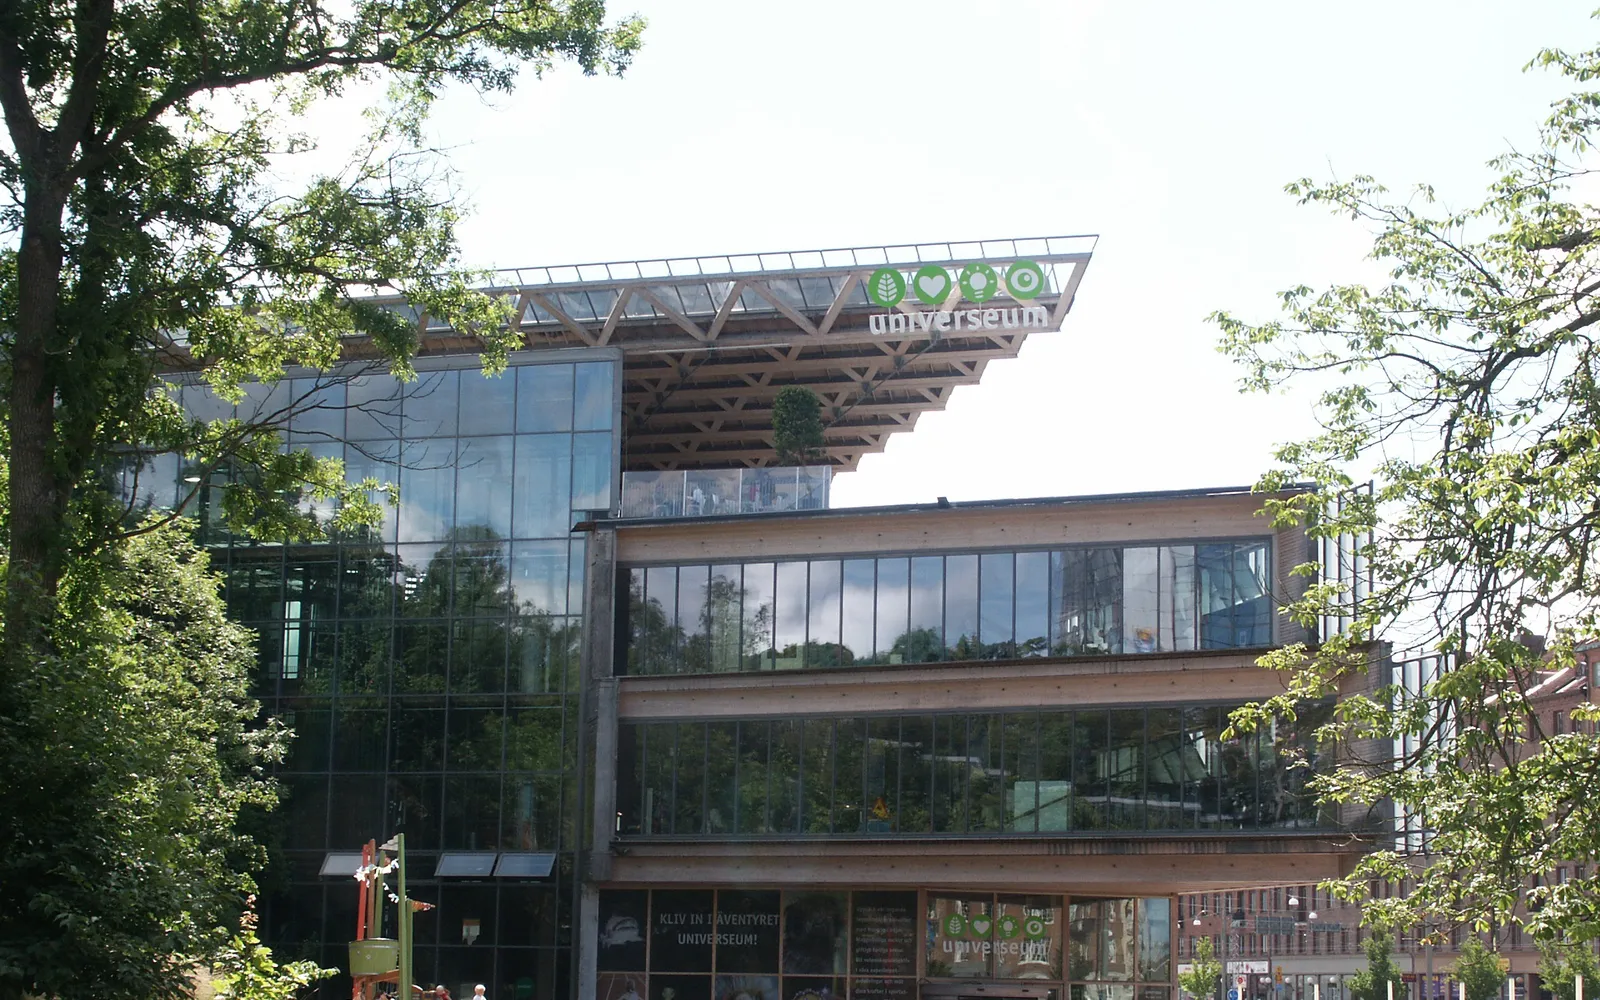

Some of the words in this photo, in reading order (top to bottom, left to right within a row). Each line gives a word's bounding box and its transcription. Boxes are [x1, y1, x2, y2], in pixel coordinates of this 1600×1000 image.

[868, 305, 1048, 336] universeum
[659, 913, 687, 925] KLIV
[690, 913, 703, 925] IN
[707, 913, 713, 925] I
[716, 910, 780, 926] ÄVENTYRET
[677, 932, 758, 946] UNIVERSEUM!
[942, 939, 1047, 956] universeum
